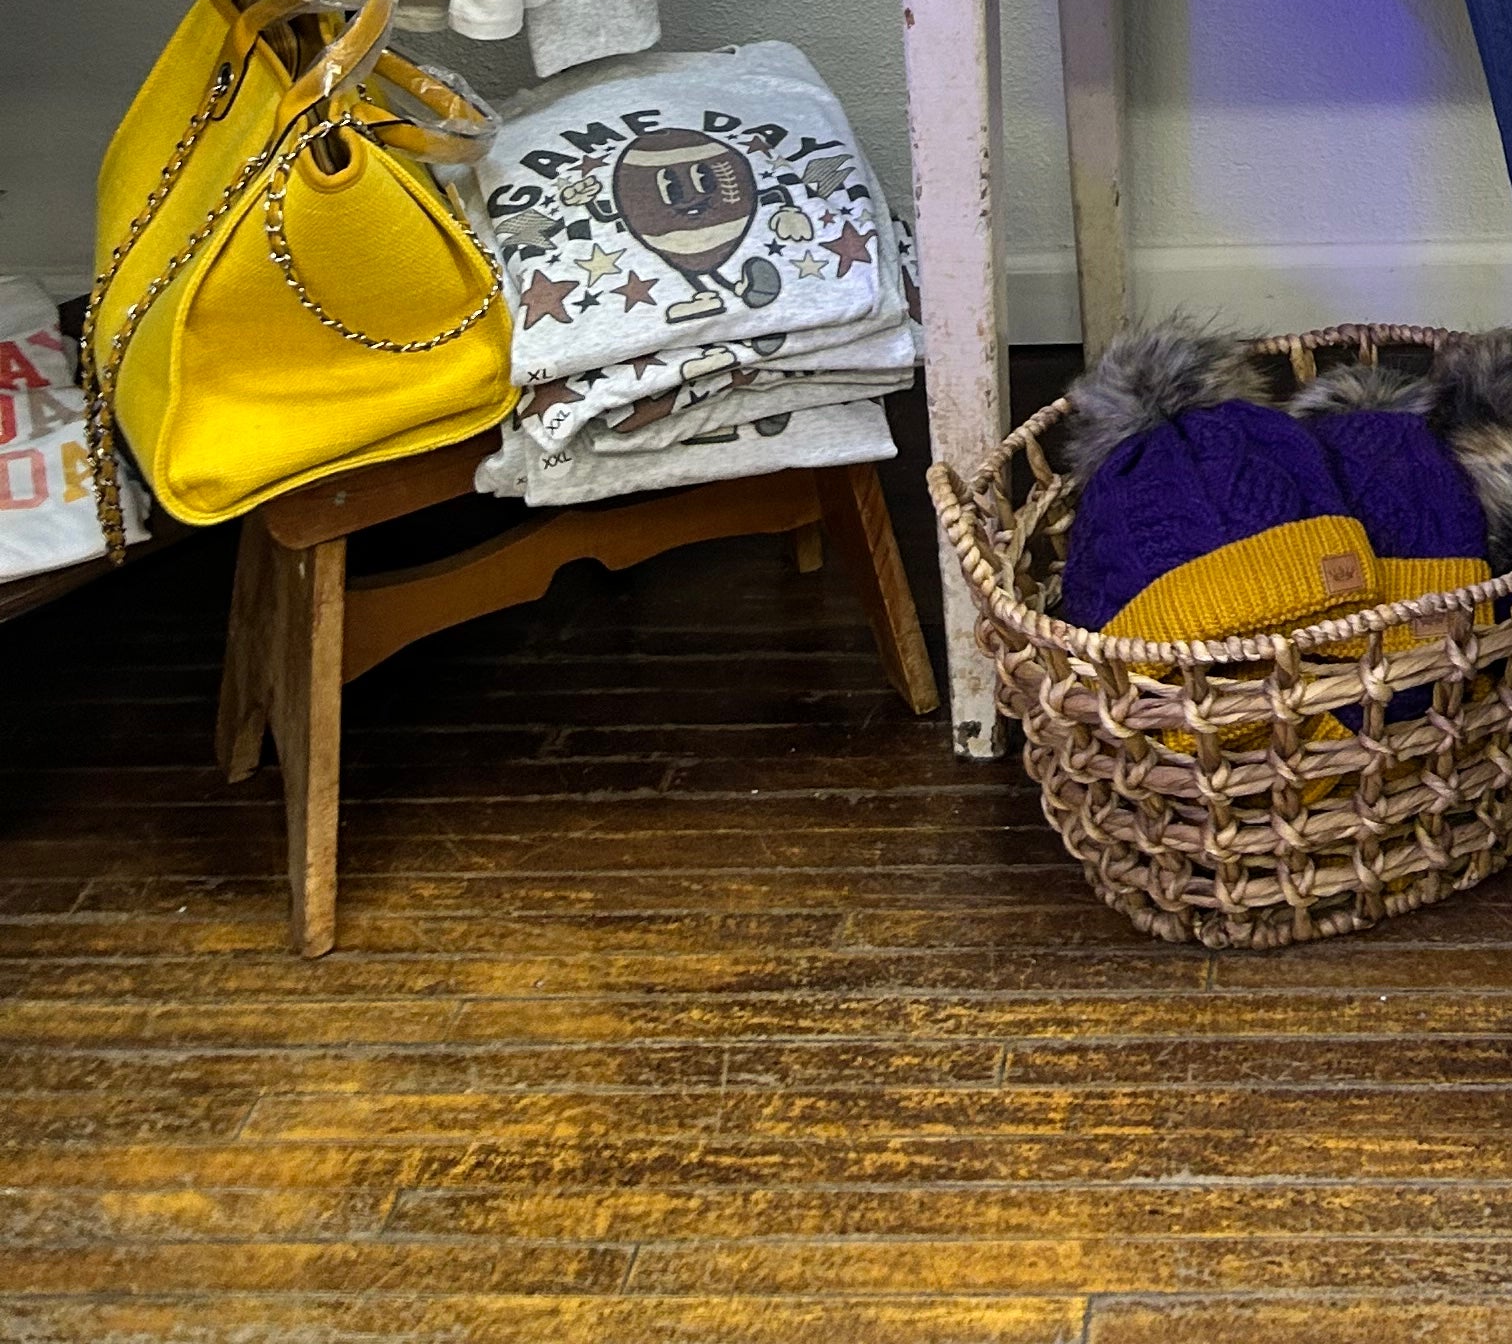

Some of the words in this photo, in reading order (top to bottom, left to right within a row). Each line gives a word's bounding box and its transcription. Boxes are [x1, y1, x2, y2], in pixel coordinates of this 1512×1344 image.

[487, 109, 661, 216] GAME
[703, 110, 846, 162] DAY
[527, 368, 553, 383] XL
[545, 409, 571, 436] XXL
[542, 451, 573, 470] XXL
